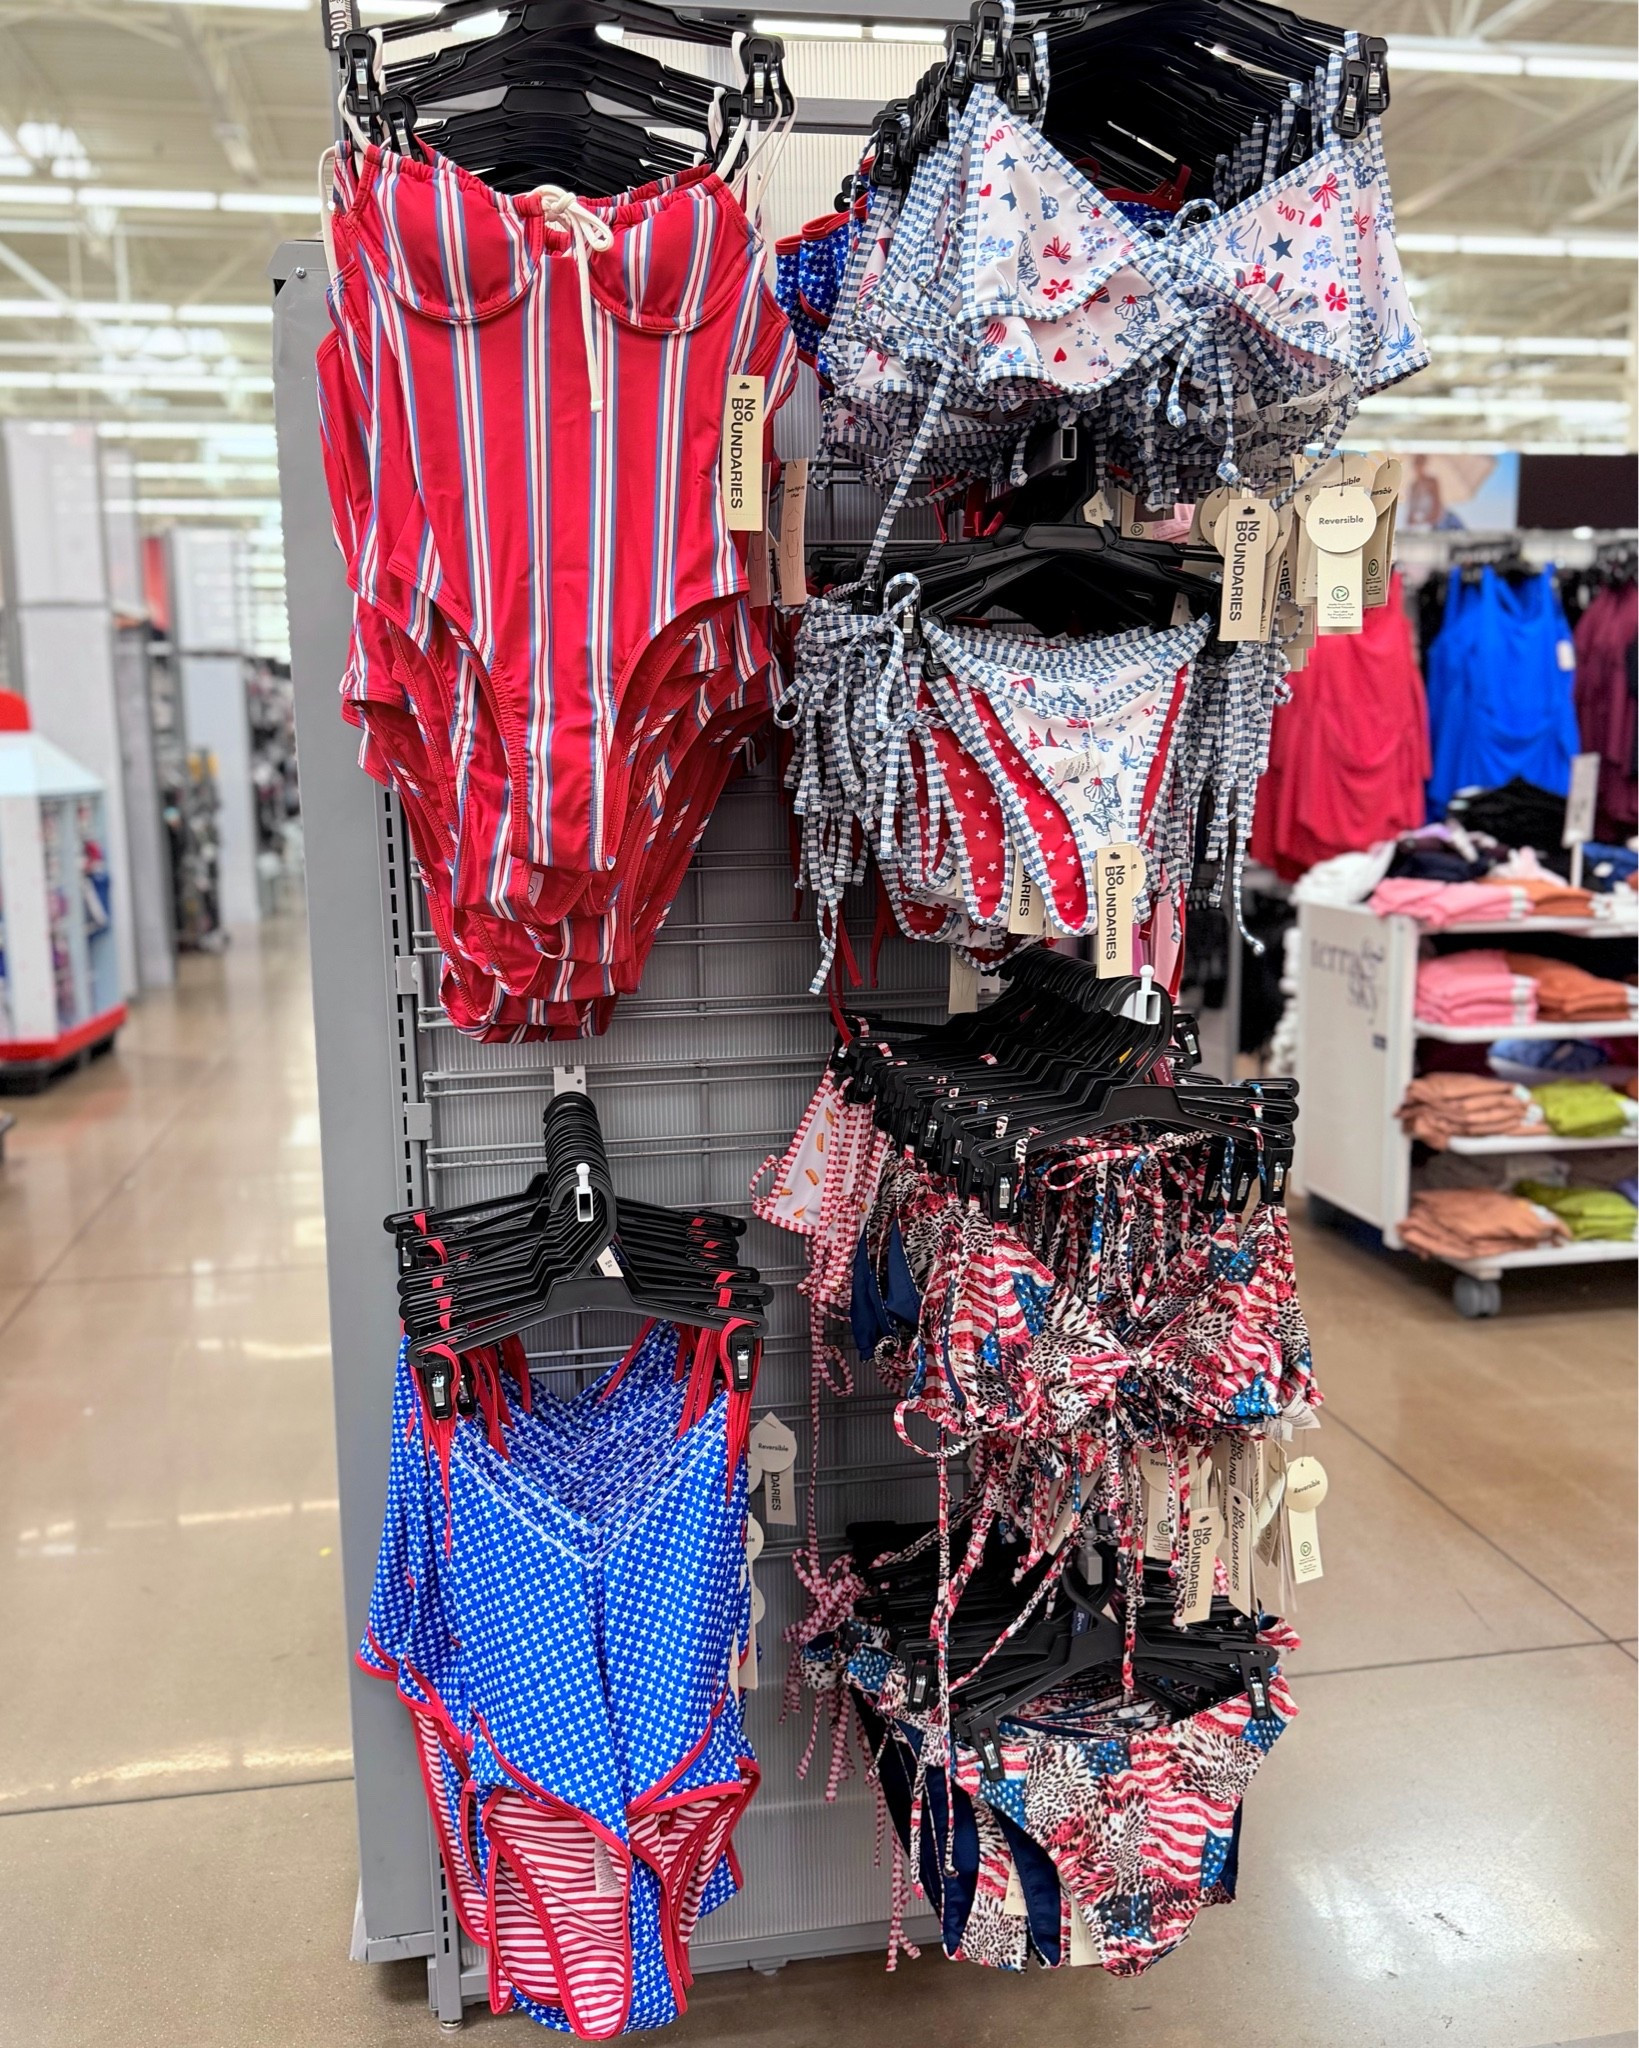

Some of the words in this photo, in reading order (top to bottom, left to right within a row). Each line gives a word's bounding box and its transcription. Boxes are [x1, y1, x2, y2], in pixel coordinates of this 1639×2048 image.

[1277, 200, 1305, 225] LOVE
[731, 397, 743, 509] BOUNDARIES
[1319, 515, 1364, 525] Reversible
[1229, 520, 1248, 621] BOUNDARIES
[1105, 866, 1117, 960] BOUNDARIES
[757, 1442, 789, 1452] Reversible
[770, 1472, 782, 1511] DARIES
[1294, 1479, 1321, 1494] Reversible
[1186, 1529, 1203, 1609] BOUNDARIES
[1231, 1506, 1241, 1592] BOUNDARIES
